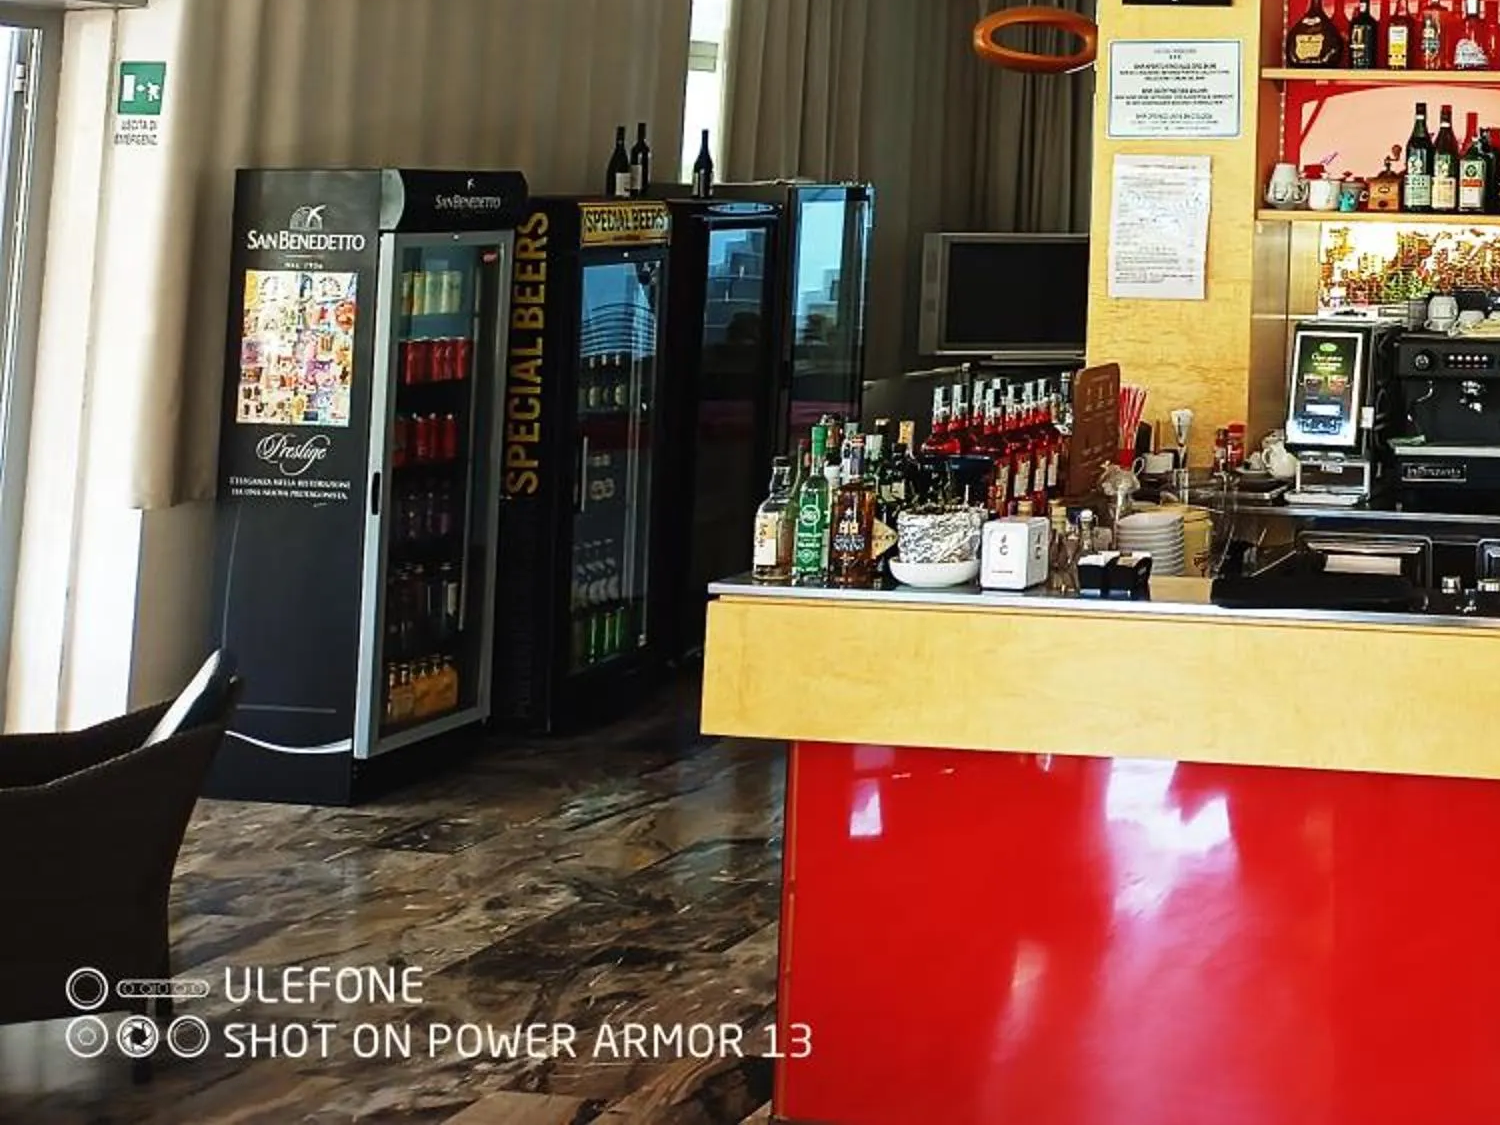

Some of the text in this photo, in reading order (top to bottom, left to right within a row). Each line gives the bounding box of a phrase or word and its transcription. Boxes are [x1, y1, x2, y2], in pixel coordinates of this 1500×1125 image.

[121, 119, 147, 130] USCITA
[585, 206, 666, 232] SPECIAL BEERS
[505, 211, 550, 495] SPECIAL BEERS
[256, 432, 331, 476] Prestige
